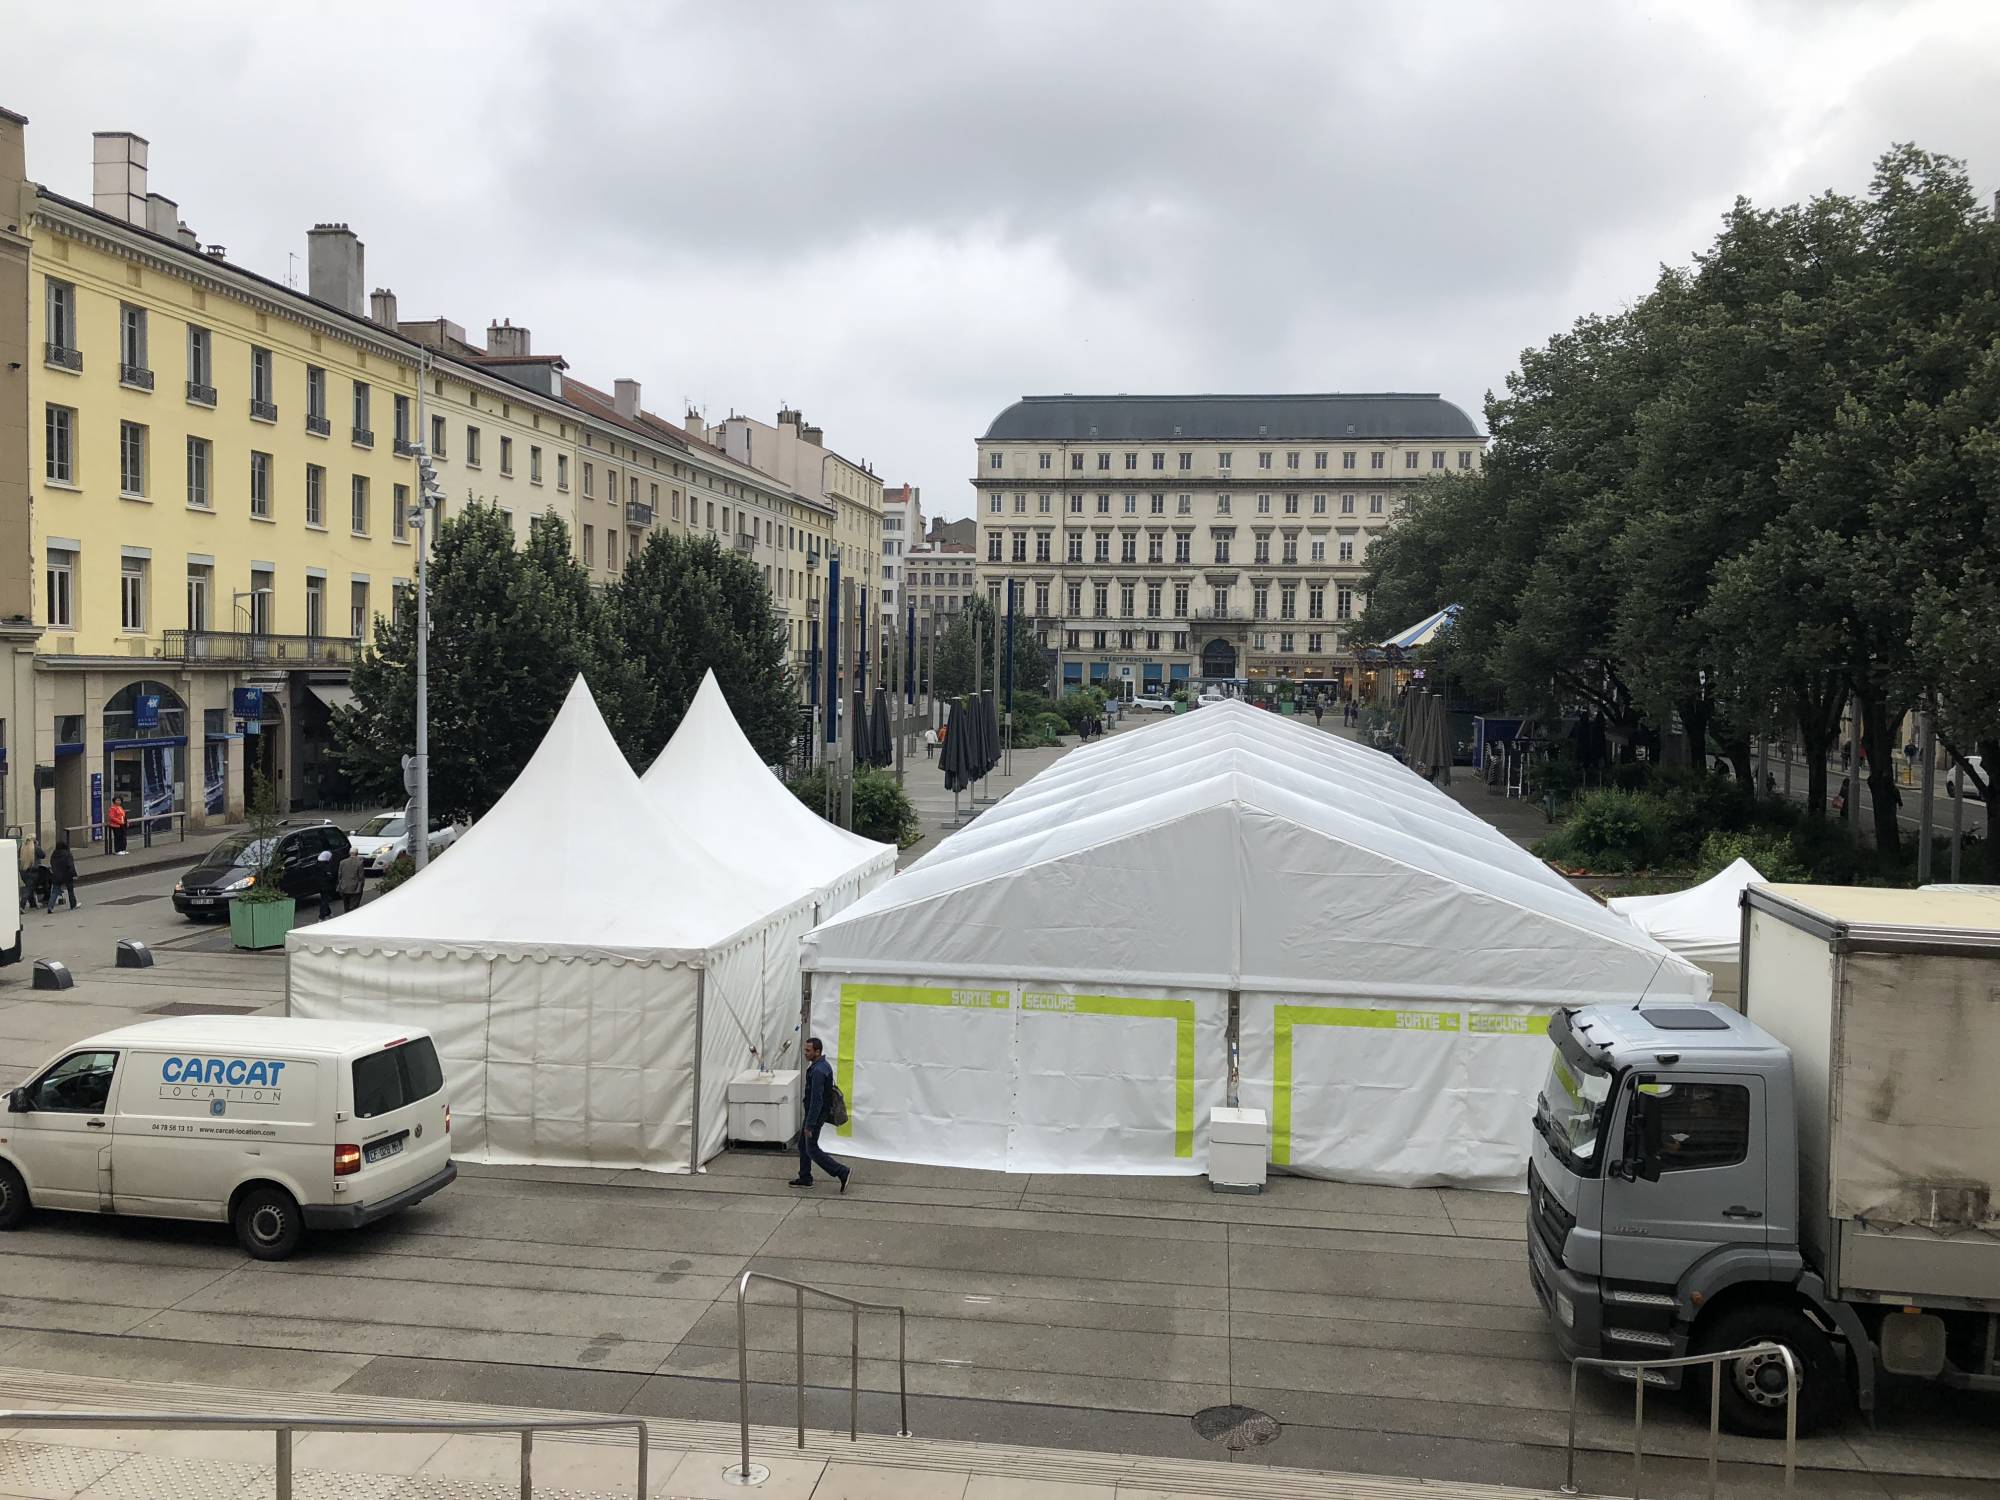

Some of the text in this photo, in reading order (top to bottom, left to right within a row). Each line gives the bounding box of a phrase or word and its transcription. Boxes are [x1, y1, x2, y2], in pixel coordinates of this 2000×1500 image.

[951, 990, 991, 1006] SORTIE
[1025, 992, 1076, 1010] SECOURS
[1396, 1012, 1440, 1030] SORTIE
[1471, 1015, 1528, 1032] SECOURS
[162, 1057, 285, 1087] CARCAT
[159, 1086, 281, 1101] LOCATION
[199, 1126, 276, 1137] www.carcat-location.com
